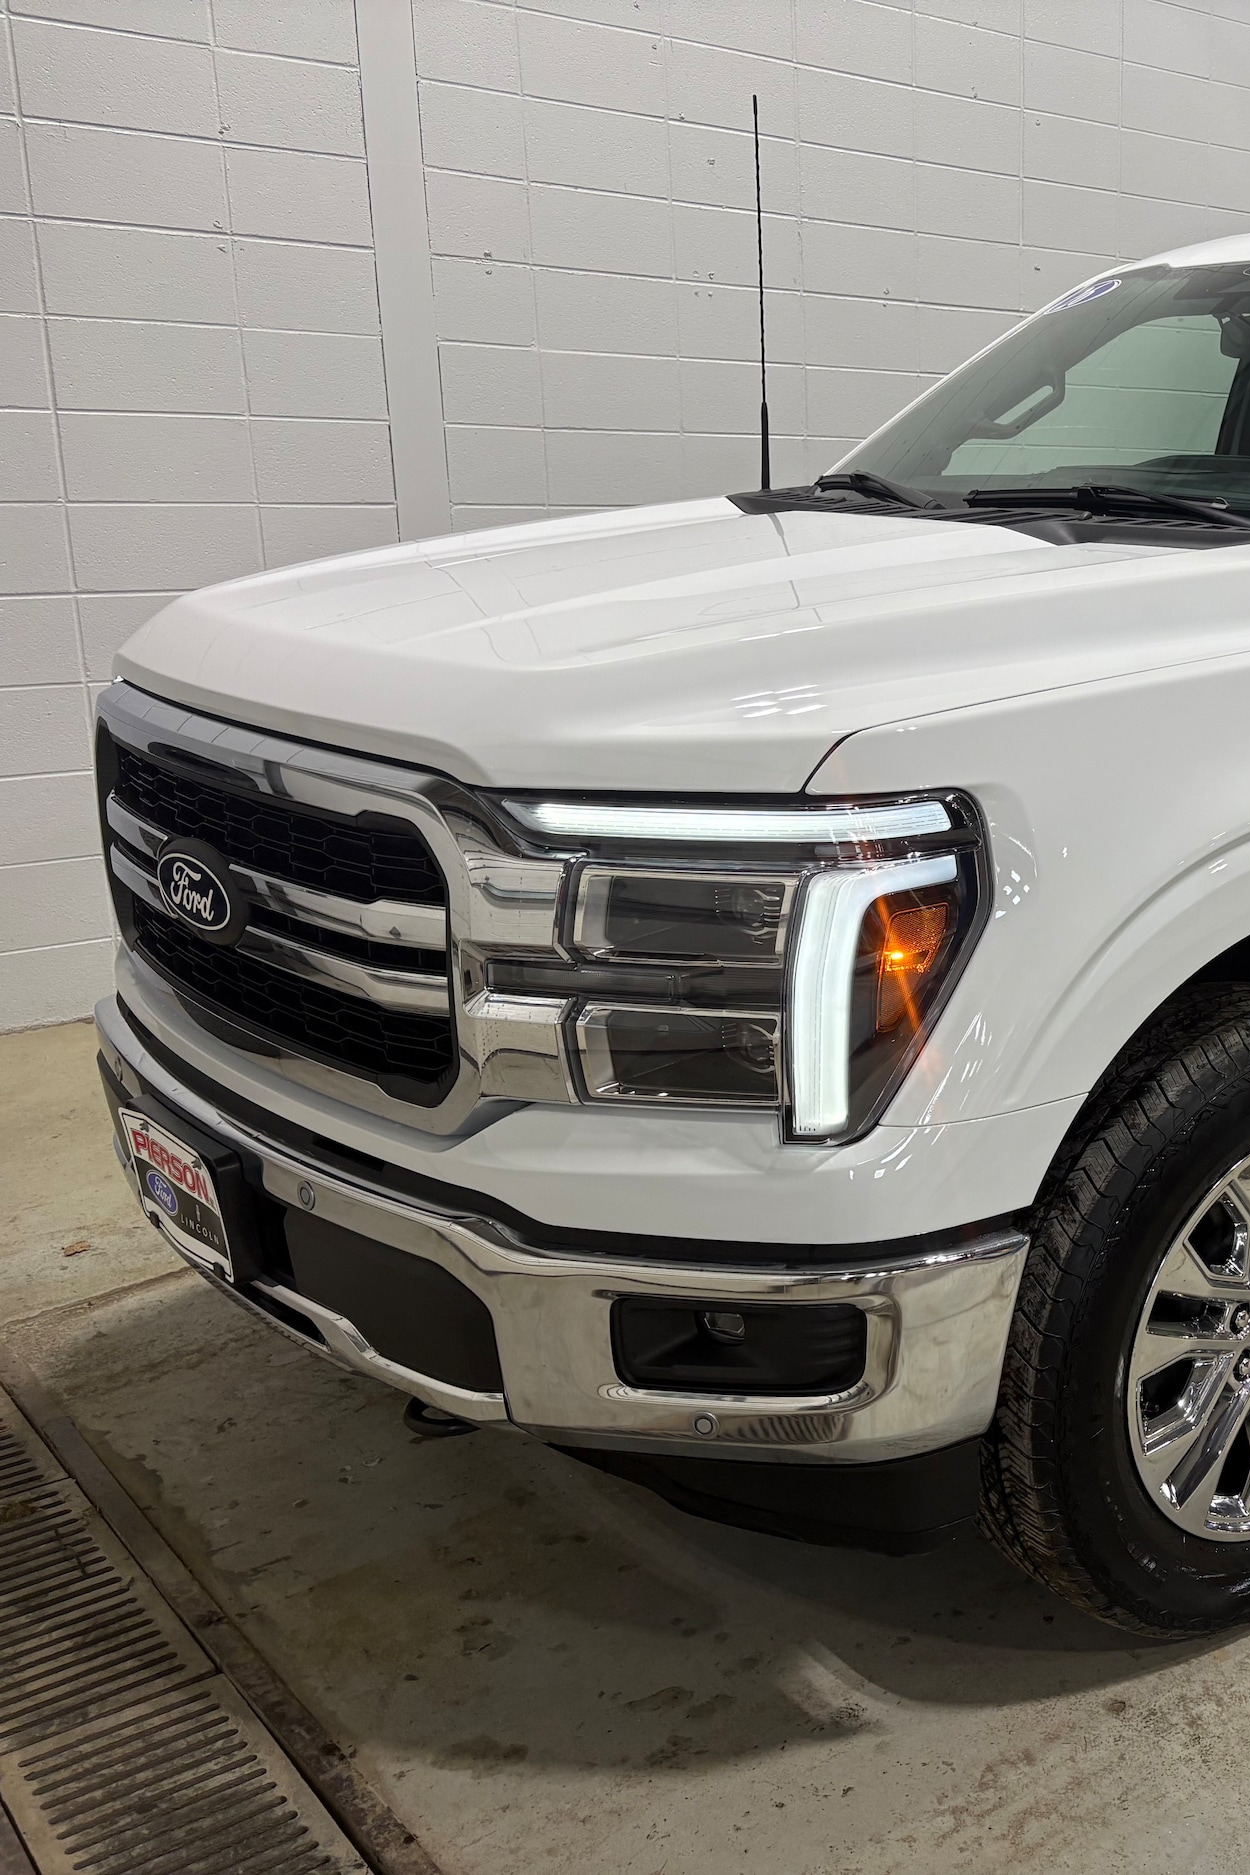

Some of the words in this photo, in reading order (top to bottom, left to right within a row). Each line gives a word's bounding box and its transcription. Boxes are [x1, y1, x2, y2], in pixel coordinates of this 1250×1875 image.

[170, 861, 214, 921] Ford
[131, 1129, 210, 1203] PIERSON
[154, 1175, 173, 1208] Ford
[180, 1213, 220, 1245] LINCOLN
